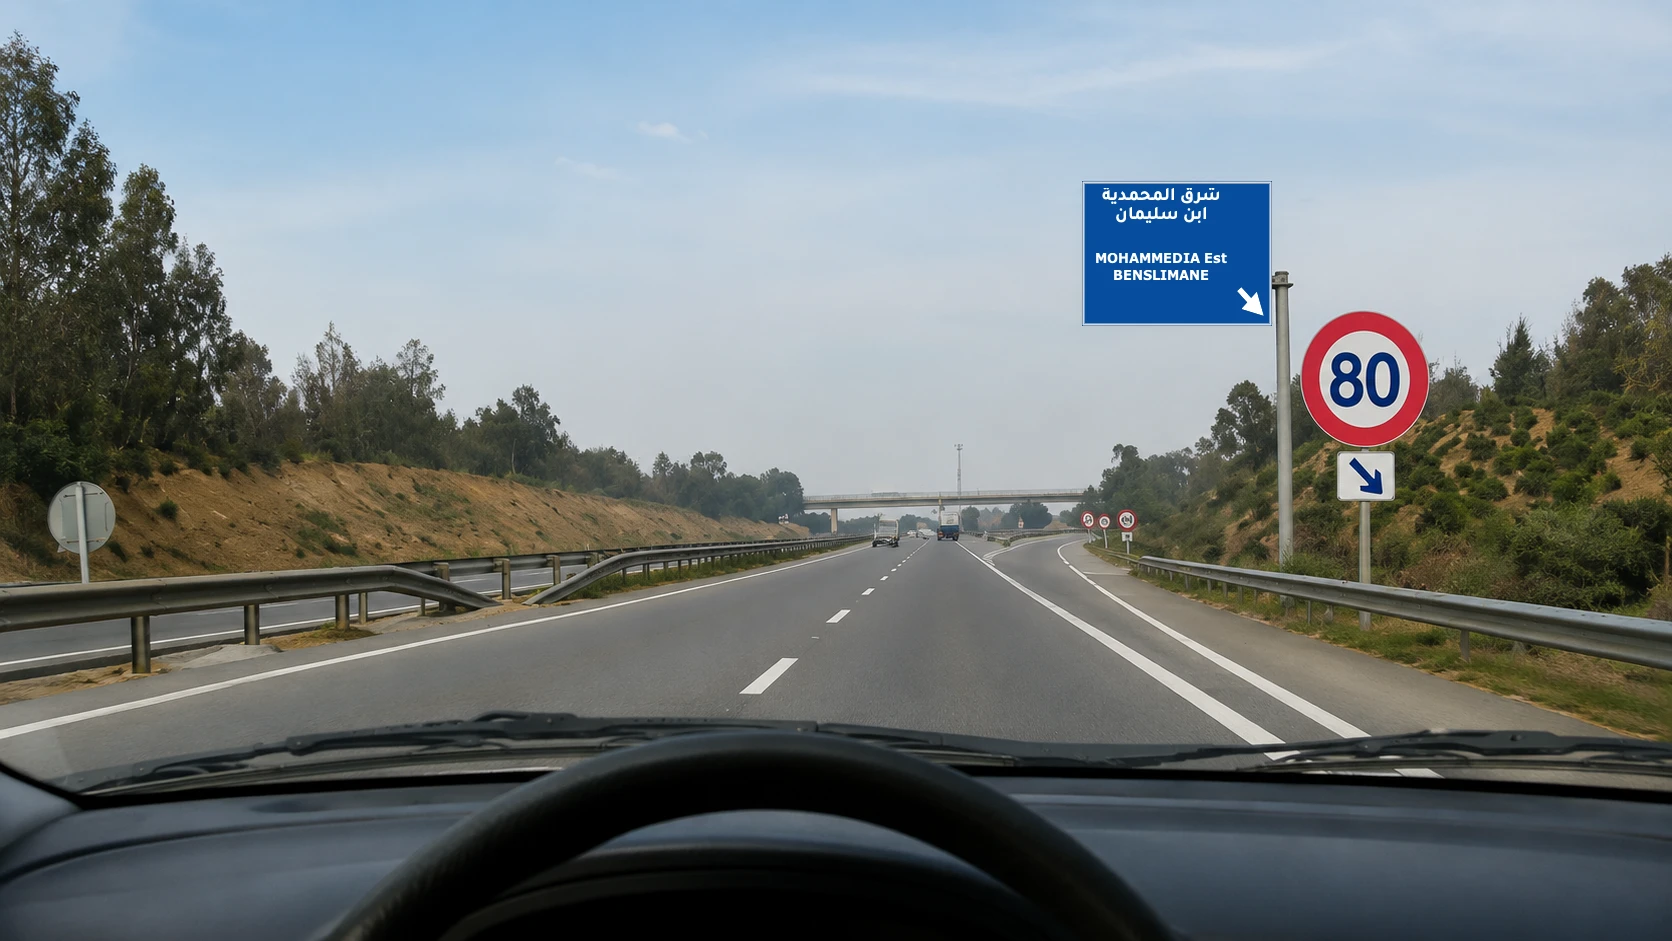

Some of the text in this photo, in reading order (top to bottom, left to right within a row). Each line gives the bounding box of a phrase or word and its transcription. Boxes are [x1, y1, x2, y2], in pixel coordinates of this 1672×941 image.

[1101, 187, 1220, 204] شرق المحمدية
[1116, 207, 1207, 223] ابن سليمان
[1095, 252, 1228, 264] MOHAMMEDIA Est
[1113, 269, 1209, 281] BENSLIMANE
[1330, 352, 1400, 407] 80
